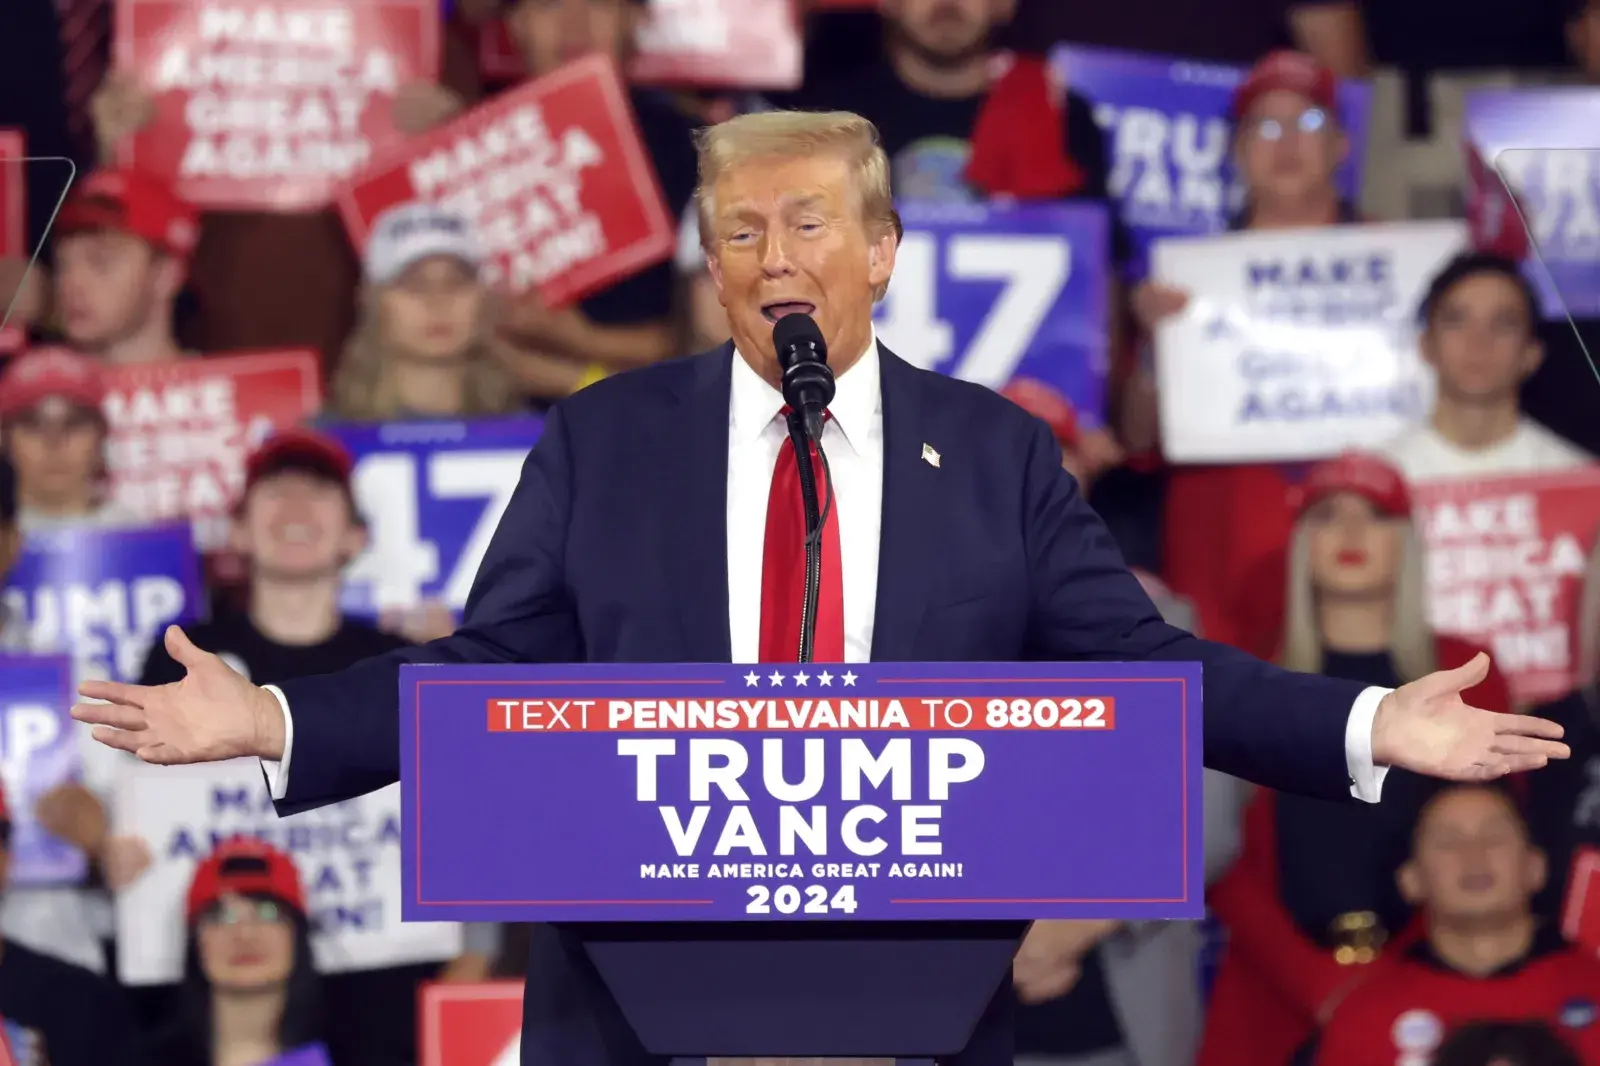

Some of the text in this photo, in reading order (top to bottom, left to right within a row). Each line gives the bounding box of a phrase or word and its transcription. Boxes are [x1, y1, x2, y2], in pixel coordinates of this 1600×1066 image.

[872, 231, 1071, 392] 47
[497, 698, 1106, 730] TEXT PENNSYLVANIA TO 88022
[617, 738, 986, 802] TRUMP
[658, 804, 943, 857] VANCE
[640, 862, 963, 879] MAKE AMERICA GREAT AGAIN!
[745, 884, 858, 914] 2024
